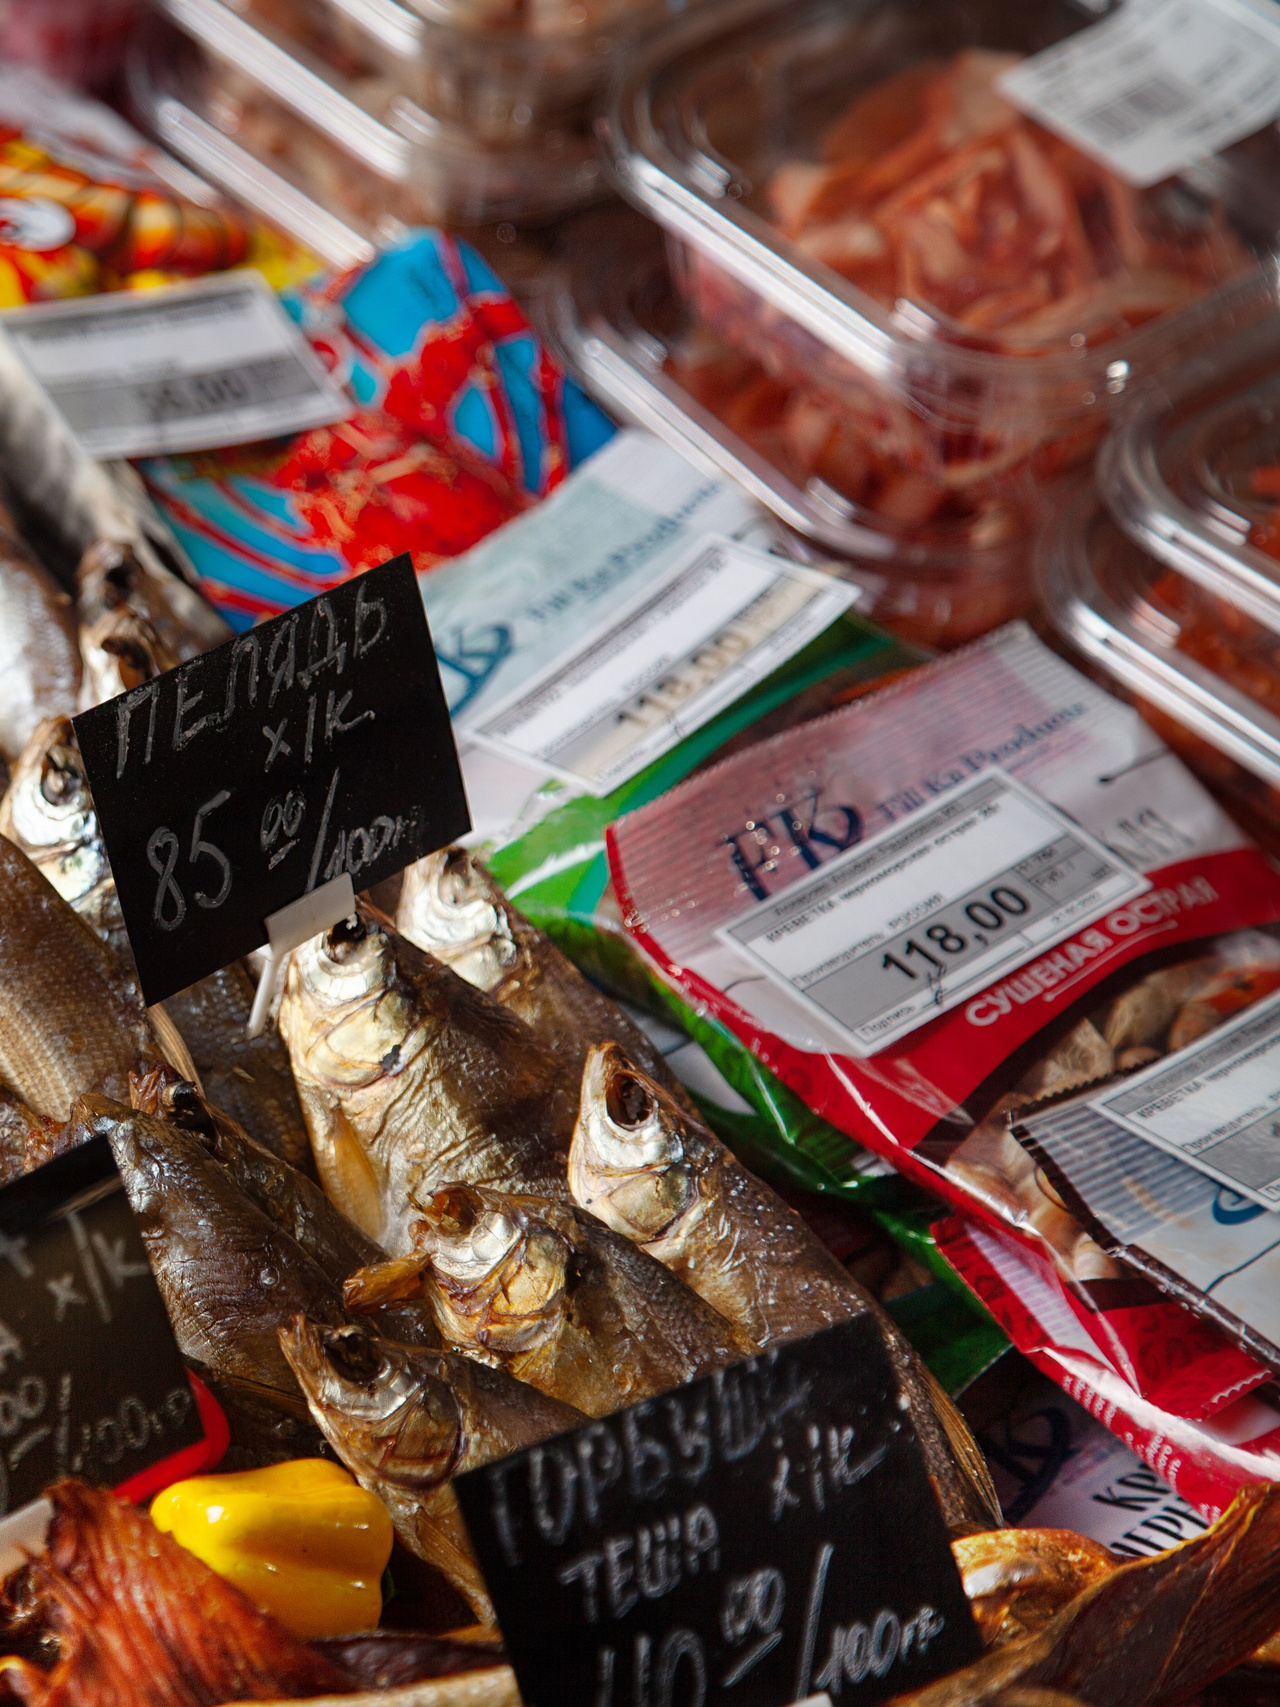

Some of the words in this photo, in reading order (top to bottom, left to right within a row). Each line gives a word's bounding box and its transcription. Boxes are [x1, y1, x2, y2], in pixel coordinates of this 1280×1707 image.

[116, 580, 388, 779] ПЕЛЯДЬ
[146, 789, 233, 931] 85
[766, 899, 837, 944] КРЕВЕТКА
[882, 886, 1028, 981] 118,00
[964, 927, 1115, 1028] СУШЕНАЯ
[1104, 875, 1220, 937] ОСТРАЯ
[1137, 1079, 1202, 1120] КРЕВЕТКА
[488, 1352, 813, 1567] ГОРБУШ
